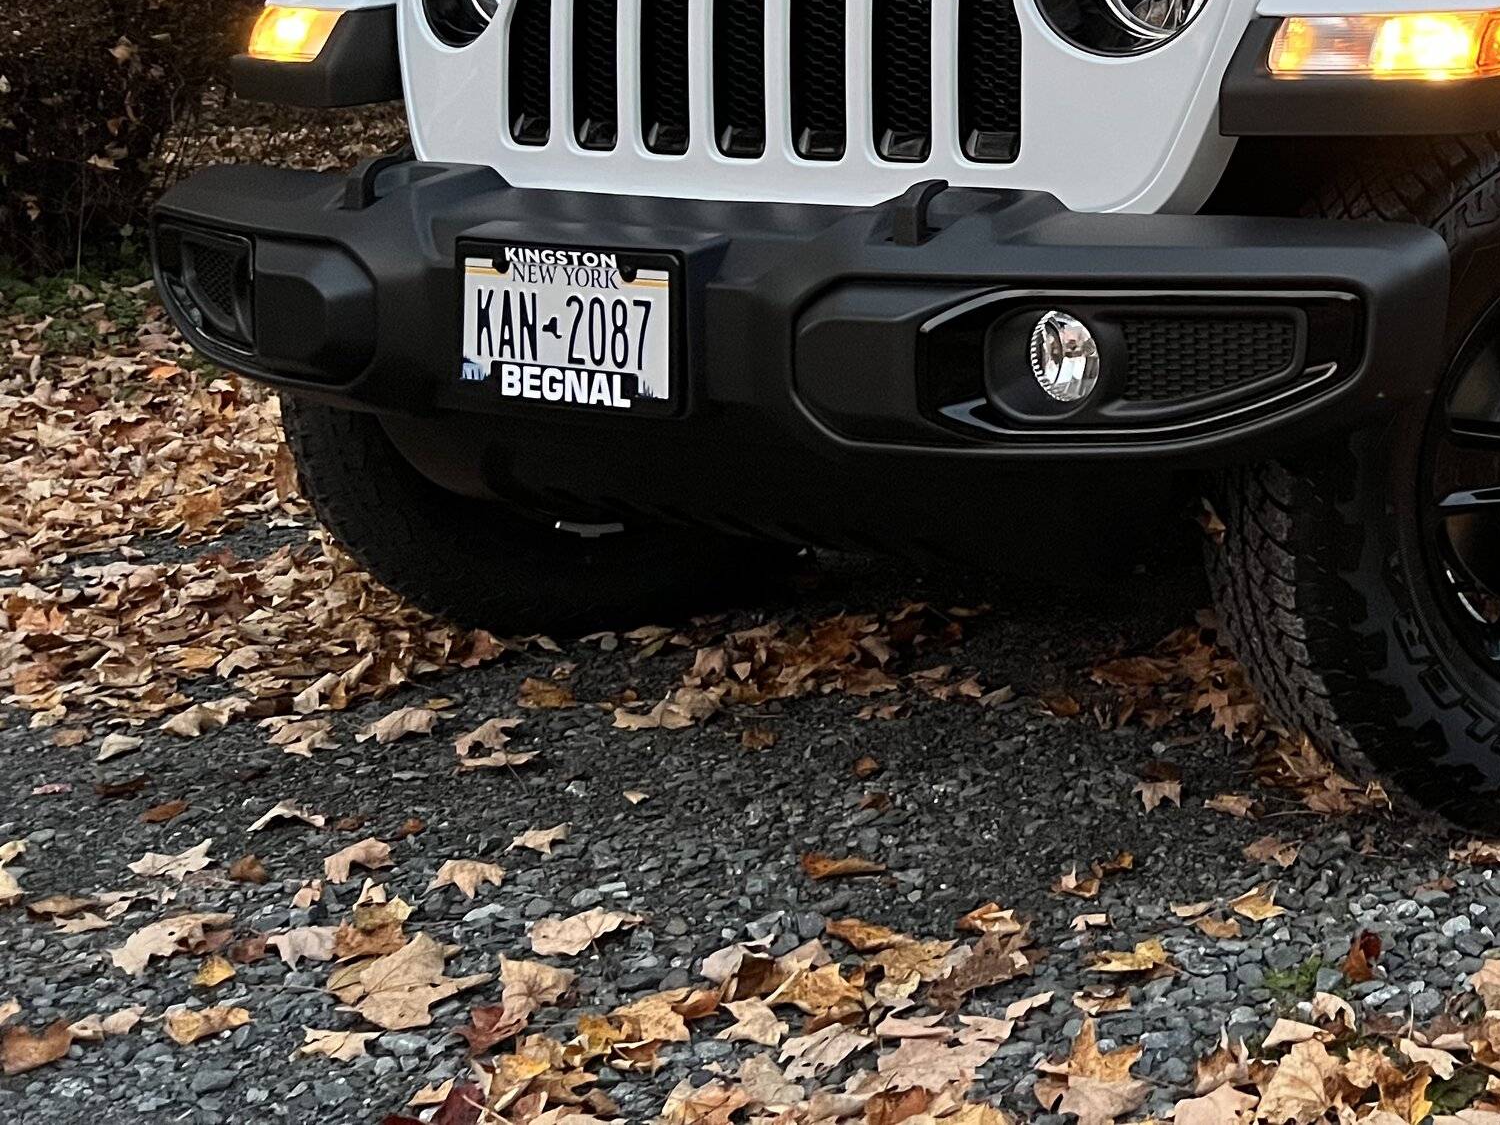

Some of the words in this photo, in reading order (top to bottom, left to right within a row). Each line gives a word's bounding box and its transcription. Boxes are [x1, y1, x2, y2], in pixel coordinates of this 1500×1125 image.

[504, 246, 617, 268] KINGSTON
[511, 262, 558, 285] NEW
[563, 266, 619, 290] YORK
[476, 288, 538, 362] KAN
[565, 295, 652, 371] 2087
[501, 363, 631, 408] BEGNAL
